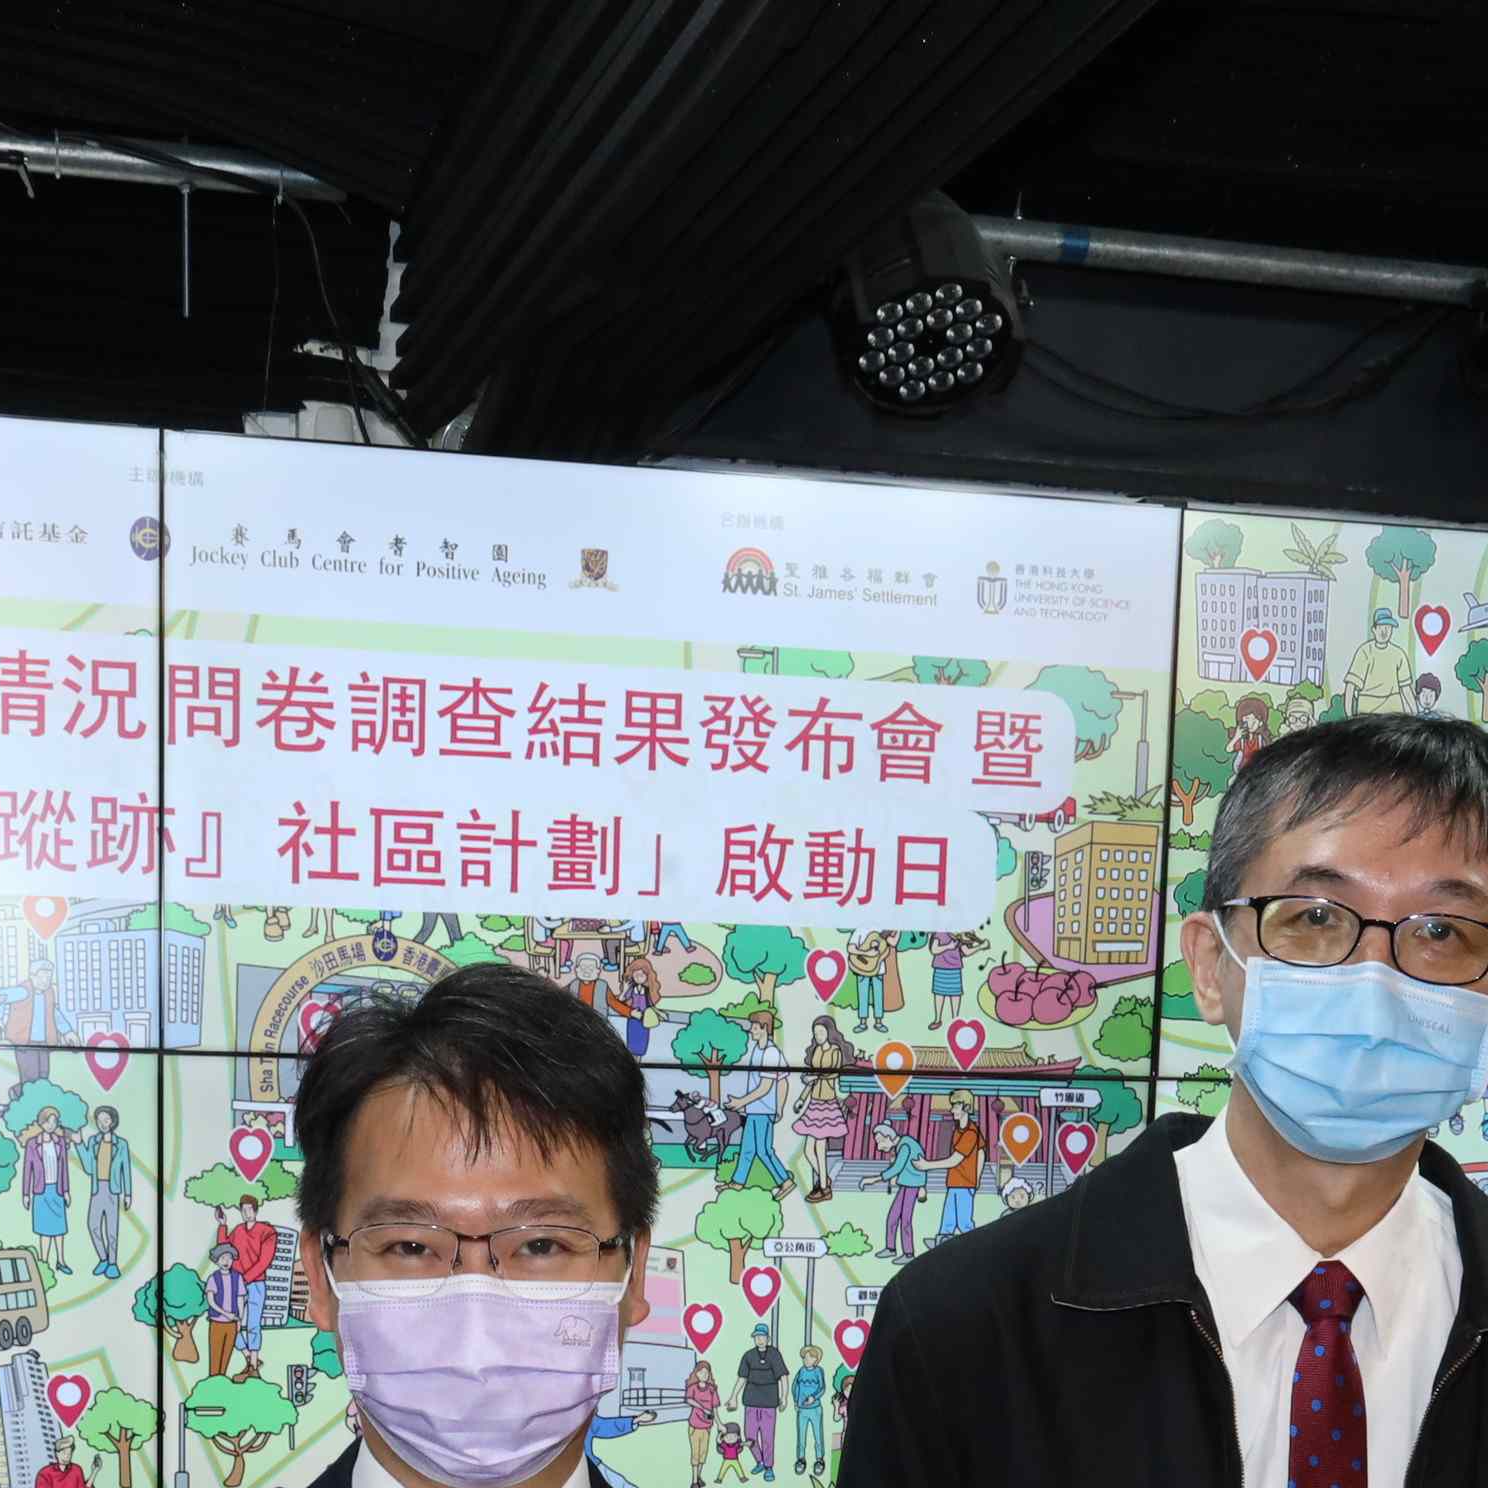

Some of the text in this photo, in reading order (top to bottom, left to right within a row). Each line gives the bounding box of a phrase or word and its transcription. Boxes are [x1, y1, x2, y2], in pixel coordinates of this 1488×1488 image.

[231, 523, 510, 563] 賽馬會耆智園
[190, 545, 548, 589] Jockey Club Centre for Positive Ageing
[783, 582, 938, 608] St. James' Settlement
[311, 941, 367, 979] 沙田馬場
[264, 975, 310, 1038] Racecourse
[260, 1069, 274, 1094] Sha
